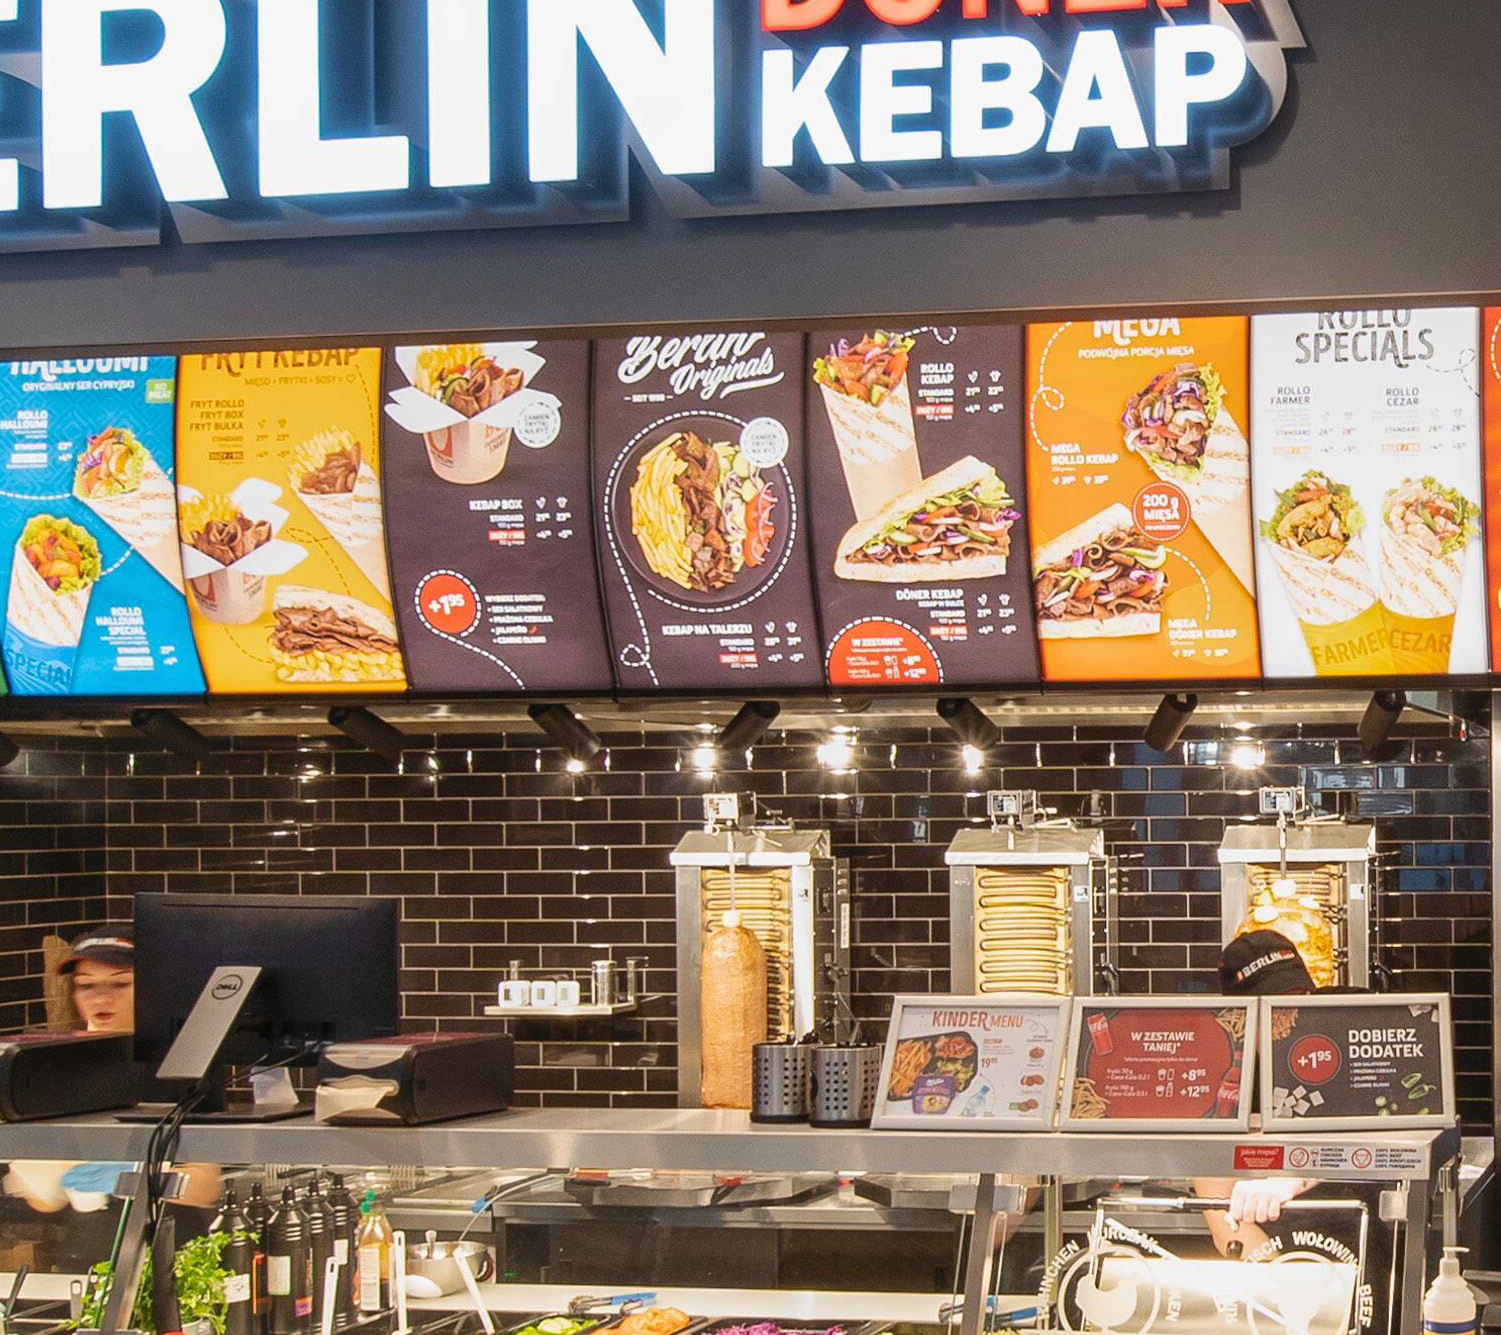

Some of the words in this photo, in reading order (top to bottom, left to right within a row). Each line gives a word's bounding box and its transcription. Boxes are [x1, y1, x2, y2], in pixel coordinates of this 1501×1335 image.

[762, 24, 1246, 166] KEBAP
[1078, 348, 1129, 359] PODWÓJNA
[1131, 347, 1164, 359] PORCJA
[1167, 345, 1195, 357] MIĘSA
[1295, 329, 1435, 368] SPECIALS
[920, 362, 954, 373] ROLLO
[669, 348, 775, 401] Originals
[921, 374, 954, 384] KEBAP
[76, 381, 93, 390] SER
[154, 383, 167, 391] NO
[1277, 386, 1310, 395] ROLLO
[148, 391, 171, 399] MEAT
[1386, 387, 1419, 397] ROLLO
[190, 400, 212, 409] FRYT
[215, 399, 245, 408] ROLLO
[1270, 396, 1310, 405] FARMER
[1387, 397, 1419, 407] CEZAR
[17, 410, 48, 419] ROLLO
[200, 411, 222, 420] FRYT
[225, 411, 244, 419] BOX
[0, 420, 48, 430] HALLOUMI
[189, 423, 212, 431] FRYT
[1051, 443, 1080, 454] MEGA
[1051, 454, 1084, 465] ROLLO
[1086, 454, 1118, 464] KEBAP
[469, 500, 500, 510] KEBAP
[502, 500, 523, 510] BOX
[1143, 494, 1167, 507] 200
[1170, 497, 1179, 512] g
[1144, 508, 1179, 522] MIĘSA
[896, 589, 930, 601] DÖNER
[931, 589, 963, 599] KEBAP
[110, 607, 142, 616] ROLLO
[1168, 618, 1198, 629] MEGA
[107, 626, 147, 636] SPECIAL
[662, 624, 694, 635] KEBAP
[694, 624, 709, 634] NA
[709, 624, 753, 635] TALERZU
[1390, 629, 1451, 653] CEZAR
[931, 1011, 991, 1032] KINDER
[990, 1015, 1024, 1028] MENU
[1131, 1032, 1142, 1041] W
[1143, 1032, 1195, 1041] ZESTAWIE
[1348, 1028, 1417, 1044] DOBIERZ
[1348, 1044, 1424, 1059] DODATEK
[1359, 1283, 1373, 1329] BEEF
